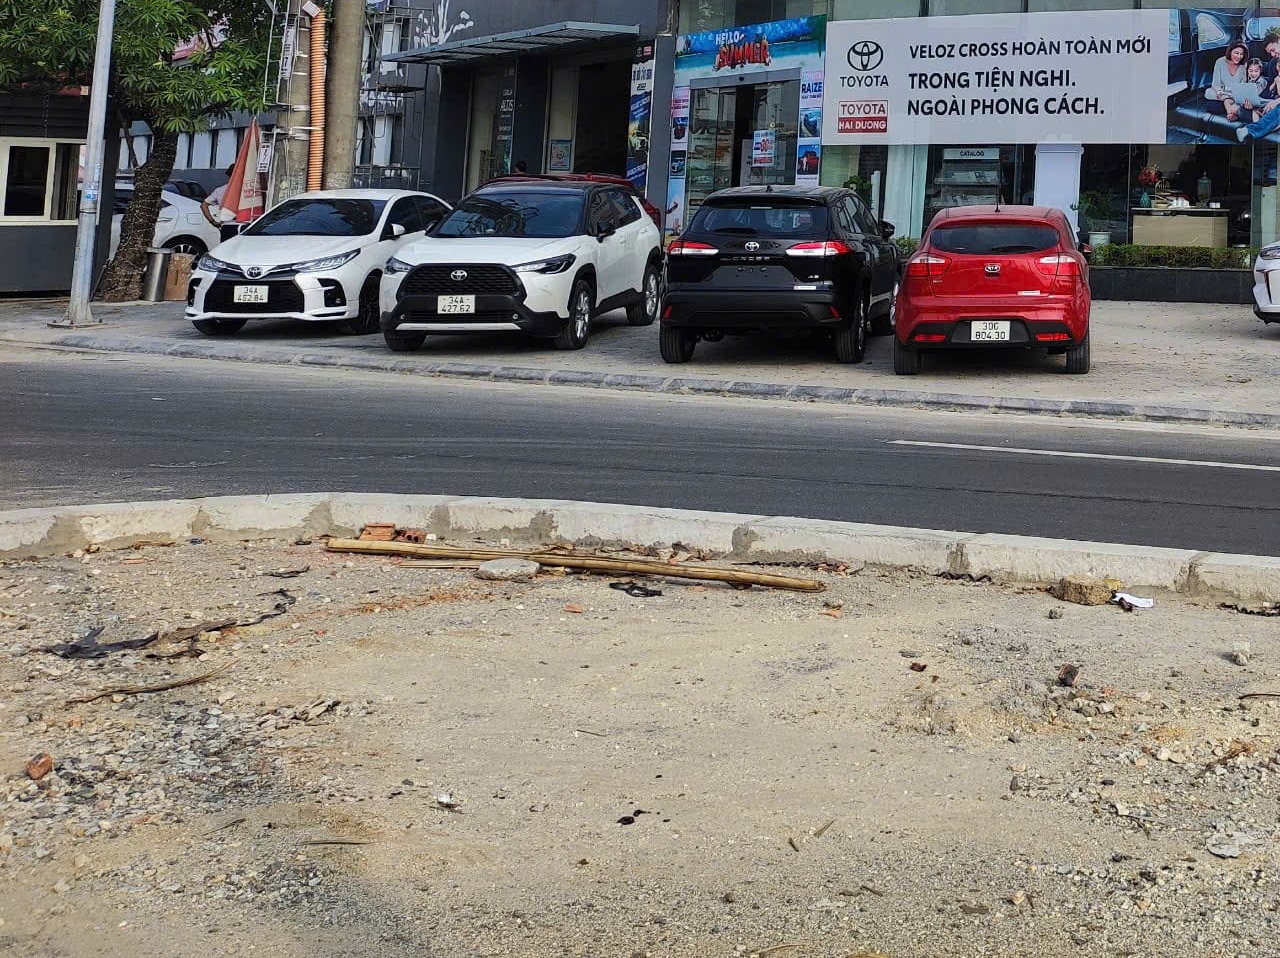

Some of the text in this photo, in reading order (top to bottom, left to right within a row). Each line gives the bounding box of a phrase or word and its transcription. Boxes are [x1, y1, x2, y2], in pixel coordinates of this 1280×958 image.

[715, 31, 740, 45] HELLO
[718, 38, 770, 68] SUMMER
[909, 35, 1151, 59] VELOZ CROSS HOÀN TOÀN MỚI
[839, 75, 889, 88] TOYOTA
[908, 67, 1076, 92] TRONG TIỆN NGHI.
[801, 81, 823, 93] RAIZE
[840, 104, 887, 115] TOYOTA
[907, 93, 1105, 116] NGOÀI PHONG CÁCH.
[975, 331, 1006, 340] 804.30
